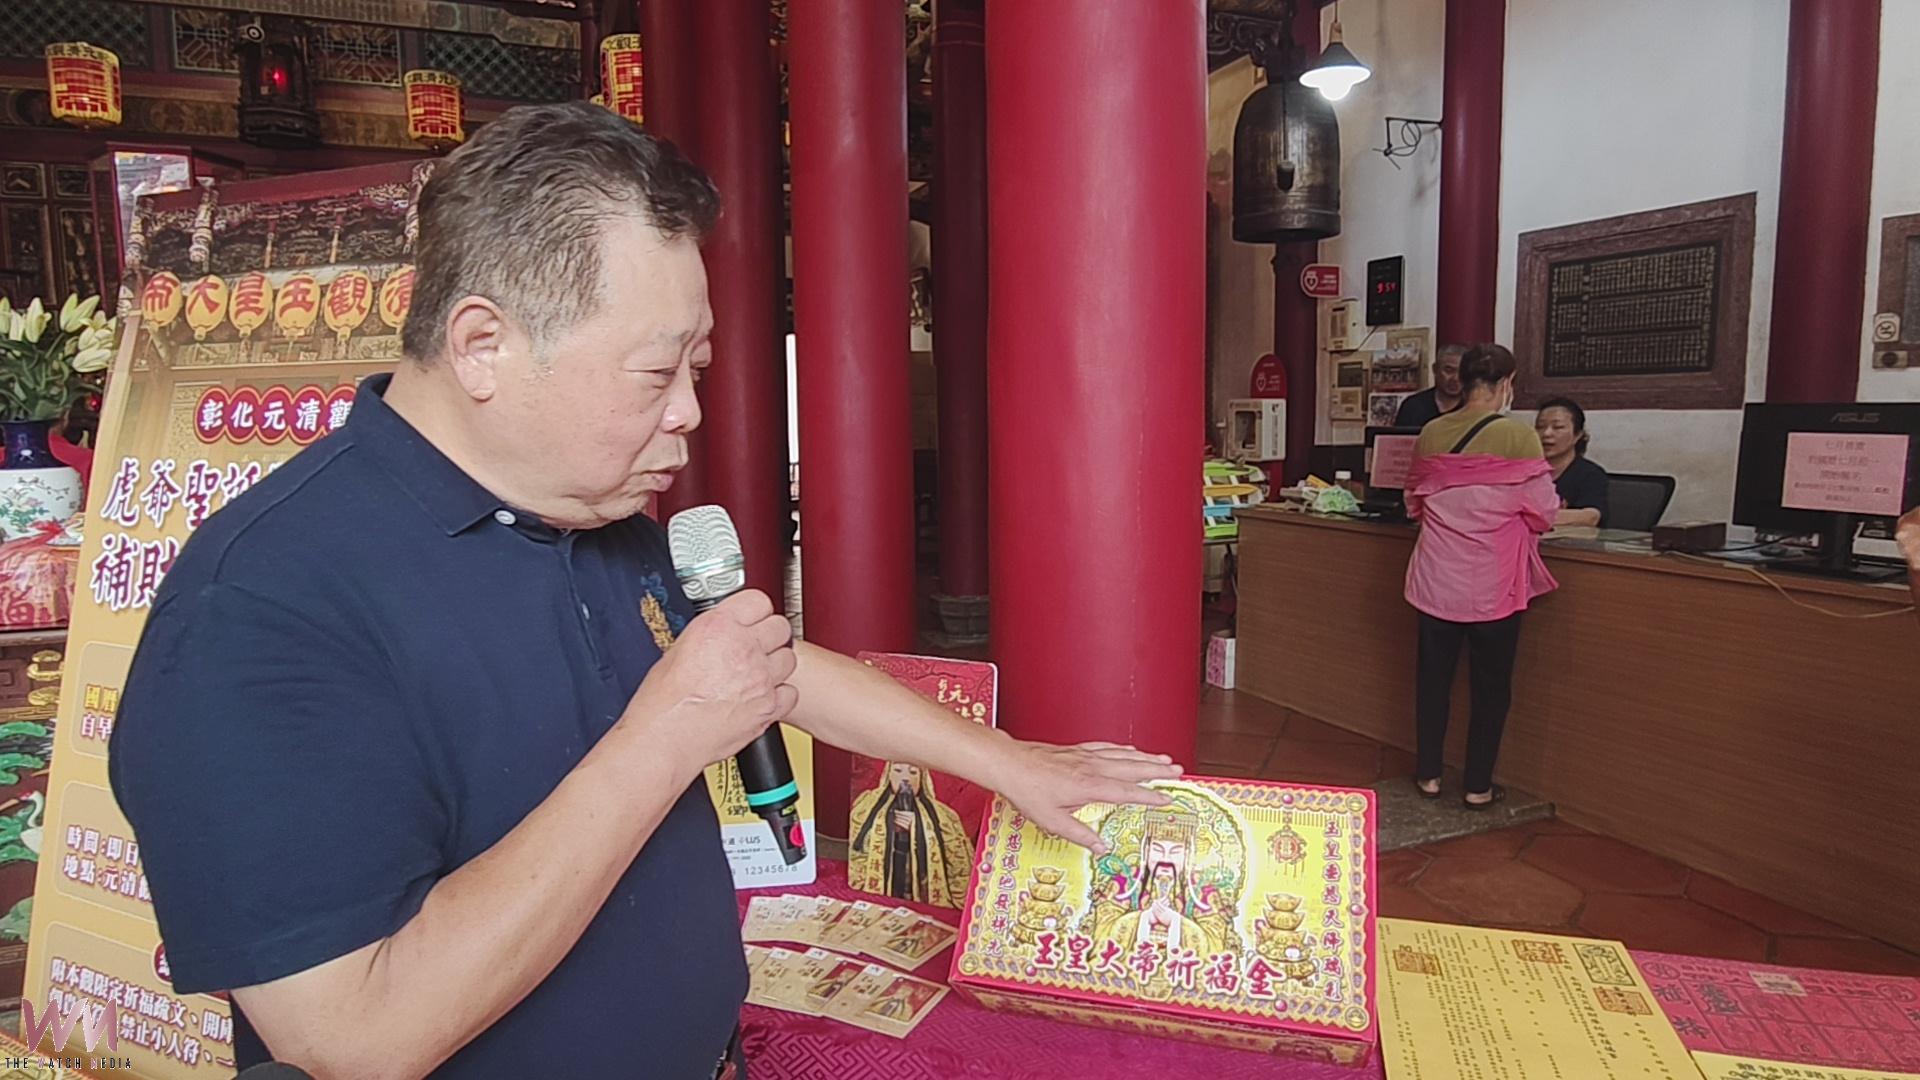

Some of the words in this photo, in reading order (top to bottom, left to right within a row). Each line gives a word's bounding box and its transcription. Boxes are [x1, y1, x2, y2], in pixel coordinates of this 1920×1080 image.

[1830, 412, 1881, 423] ASUS
[1033, 932, 1285, 997] 玉皇大帝祈福金
